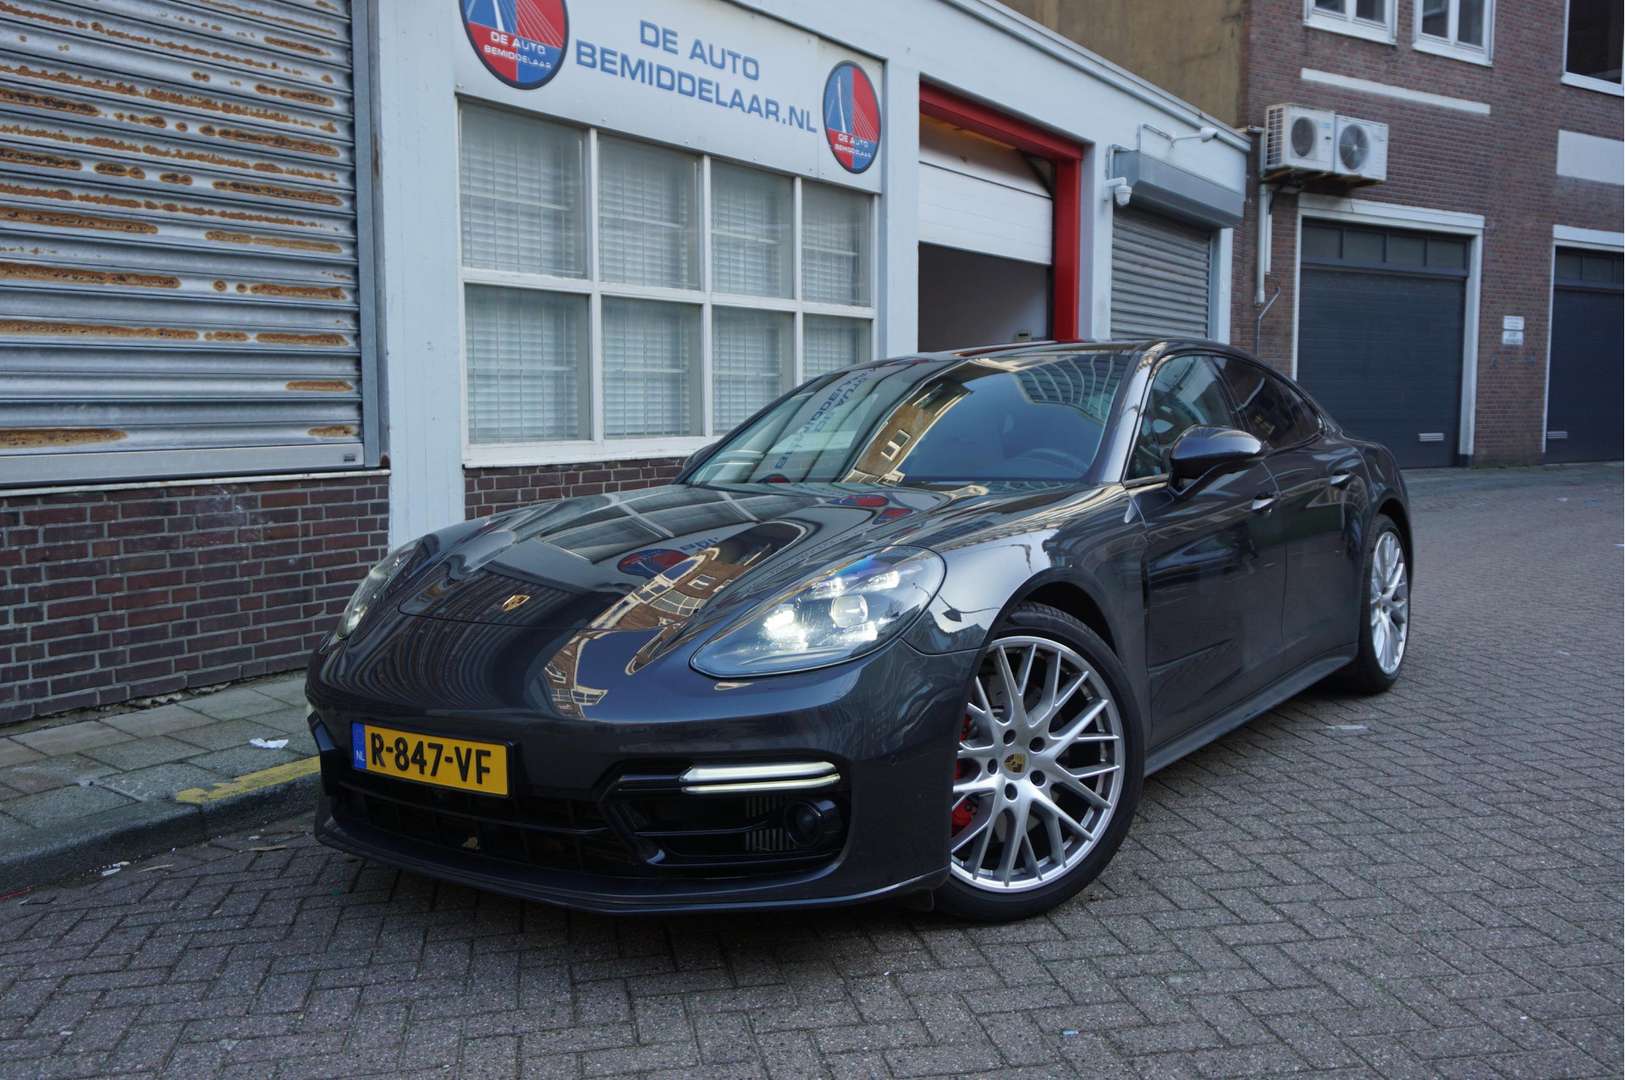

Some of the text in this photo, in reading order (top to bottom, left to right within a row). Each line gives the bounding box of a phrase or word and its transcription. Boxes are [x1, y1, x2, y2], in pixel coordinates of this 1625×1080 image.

[484, 44, 552, 69] BEMIDDELAAR
[490, 31, 546, 55] DE AUTO
[640, 19, 760, 81] DE AUTO
[575, 38, 818, 133] BEMIDDELAAR.NL
[355, 750, 366, 762] NL
[370, 732, 492, 785] R-847-VF
